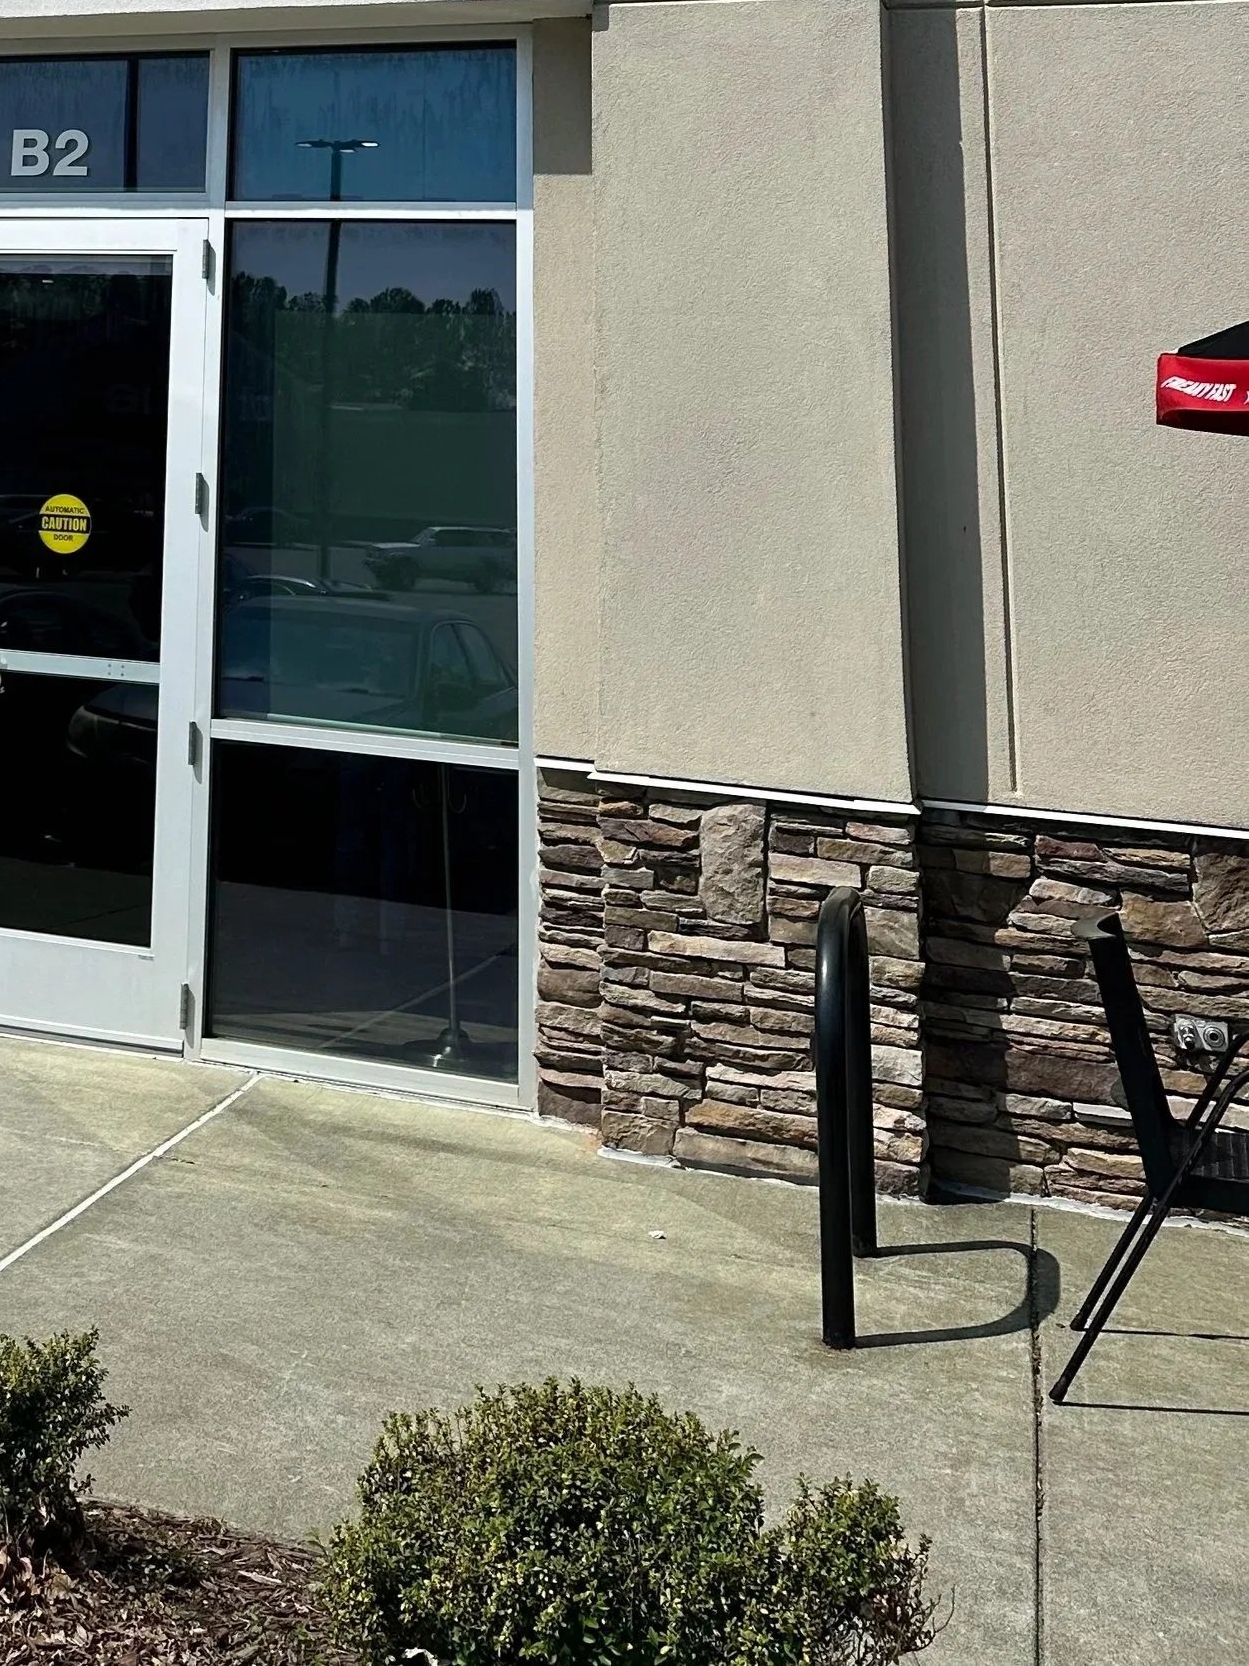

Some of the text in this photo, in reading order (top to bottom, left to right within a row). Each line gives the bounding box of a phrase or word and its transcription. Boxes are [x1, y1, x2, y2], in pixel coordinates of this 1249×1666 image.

[11, 129, 89, 176] B2
[45, 505, 85, 515] AUTOMATIC
[41, 516, 87, 532] CAUTION
[53, 533, 73, 542] DOOR
